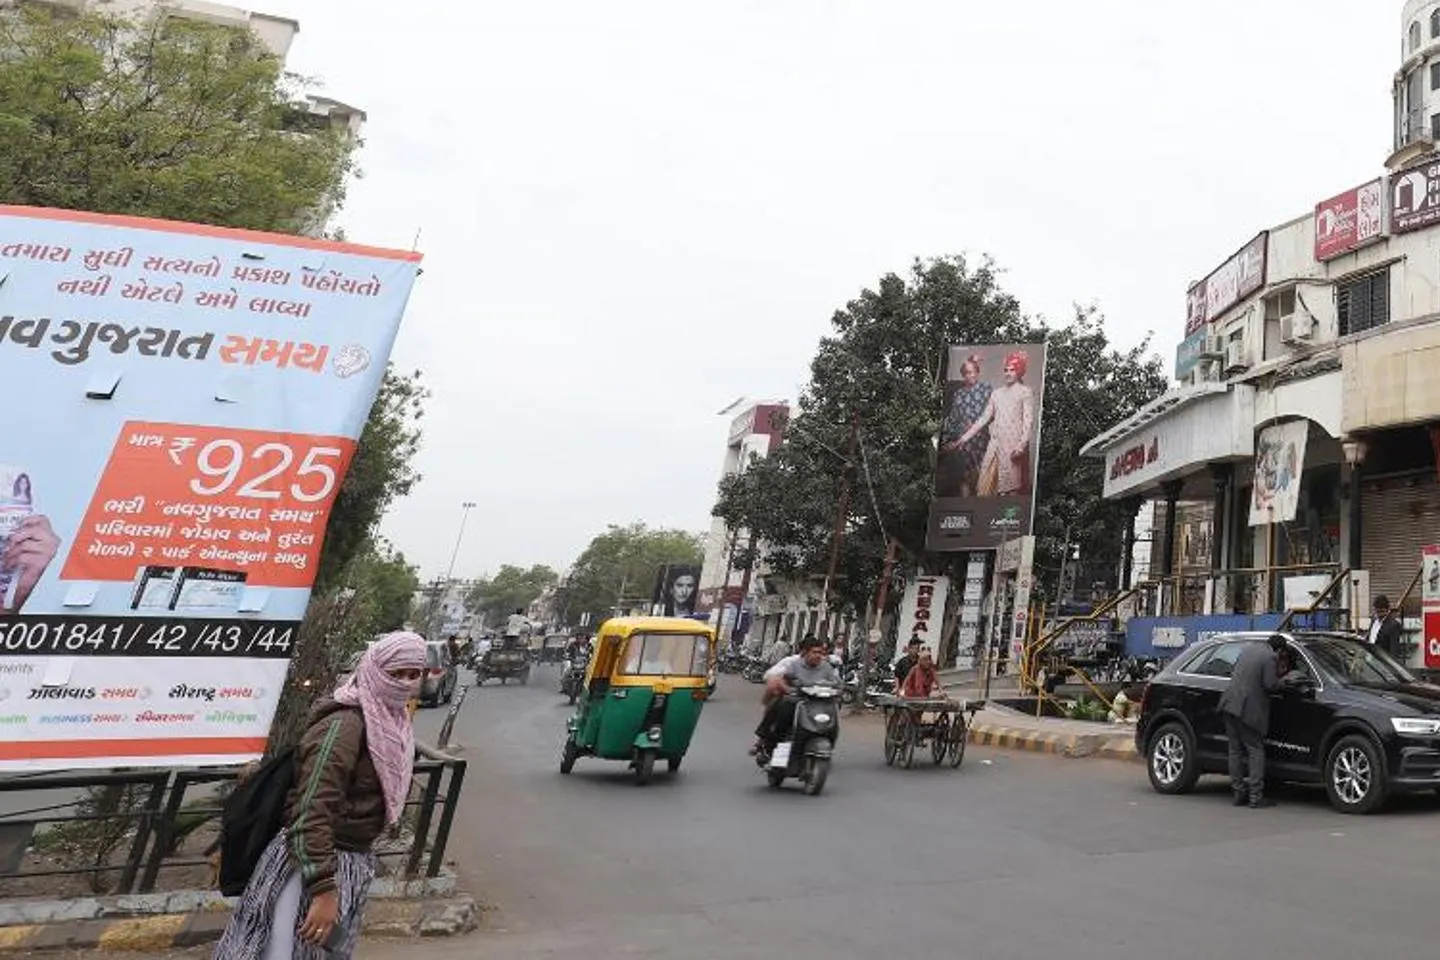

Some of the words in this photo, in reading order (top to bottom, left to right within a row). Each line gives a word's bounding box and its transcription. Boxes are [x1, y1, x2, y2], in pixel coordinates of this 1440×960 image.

[1, 242, 72, 262] તમારા
[84, 246, 134, 271] સુધી
[143, 255, 221, 278] સત્યનો
[231, 265, 290, 286] પ્રકાશ
[302, 269, 382, 297] પહોંચતો
[57, 275, 112, 297] નથી
[121, 278, 184, 304] એટલે
[194, 287, 239, 310] અમે
[249, 296, 312, 318] લાવ્યા
[219, 333, 330, 374] સમય
[103, 496, 146, 514] ભરી
[87, 541, 136, 558] મેળવો
[238, 528, 271, 543] અને
